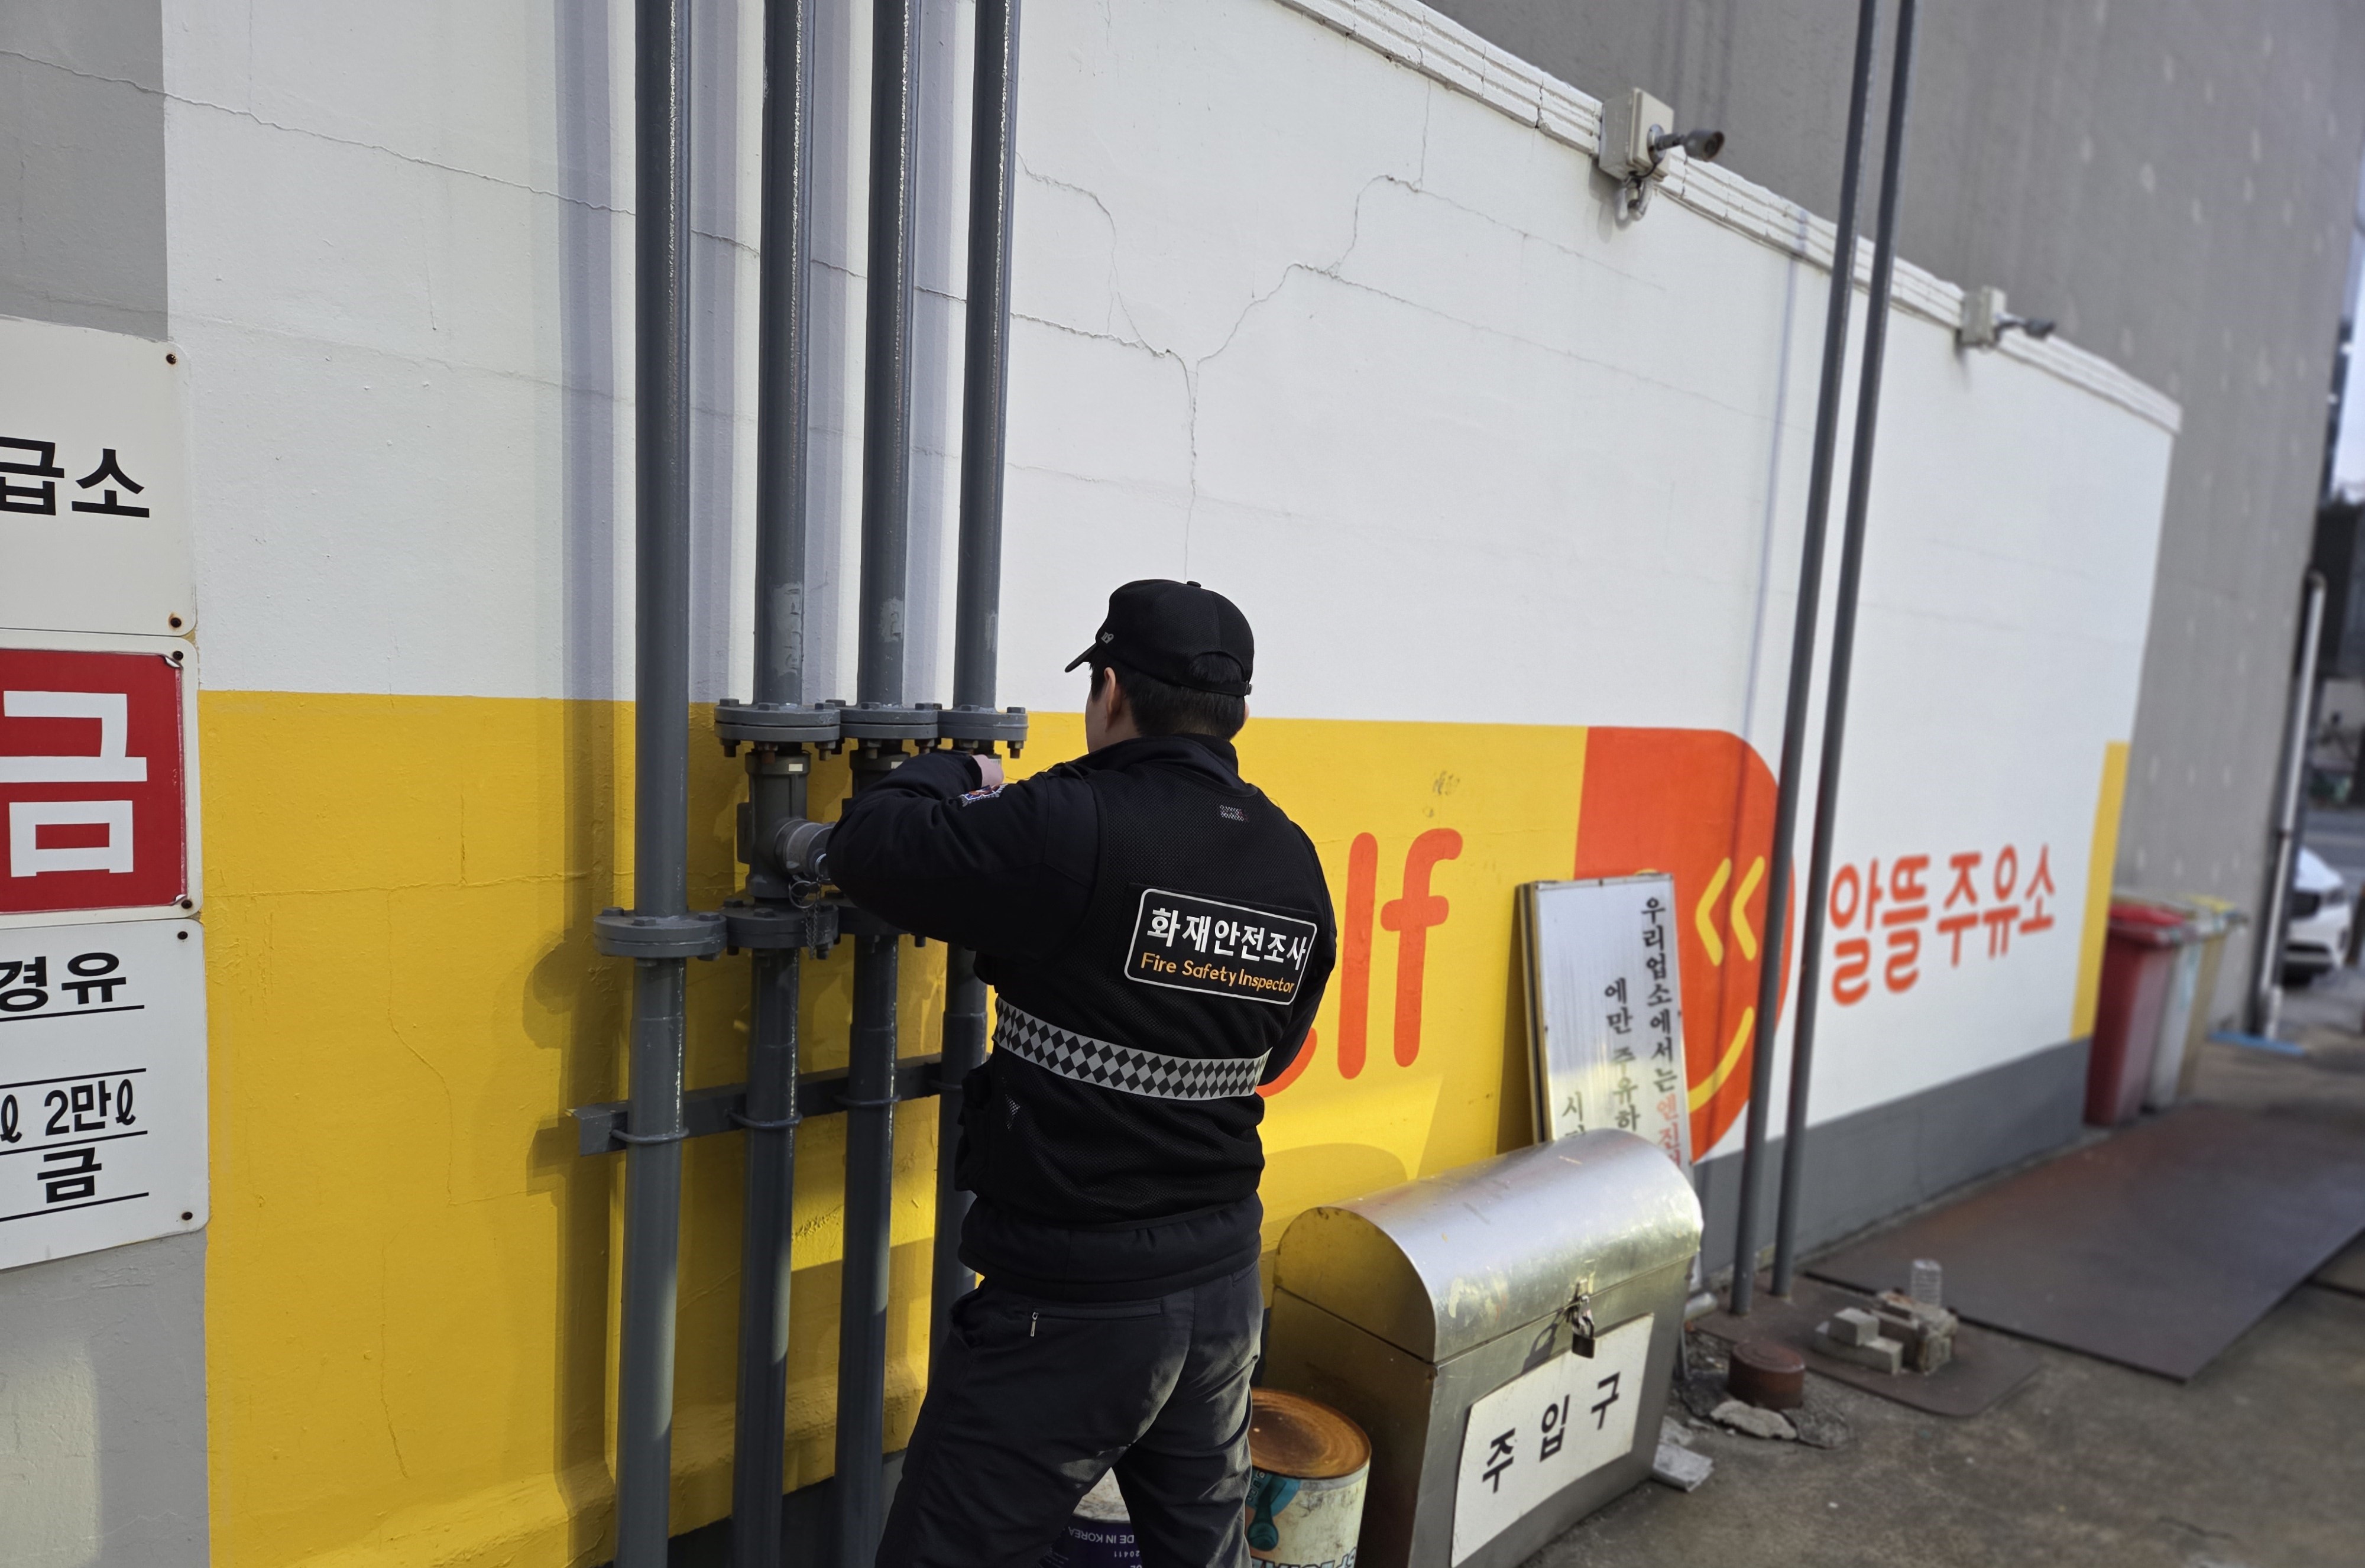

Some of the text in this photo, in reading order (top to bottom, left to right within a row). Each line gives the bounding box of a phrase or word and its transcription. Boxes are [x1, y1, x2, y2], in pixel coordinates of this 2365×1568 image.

[0, 690, 147, 877] 금
[1147, 907, 1307, 971] 화재안전조사
[1829, 843, 2056, 1007] 알뜰주유소
[0, 952, 127, 1012] 경유
[1141, 952, 1295, 993] Fire Safety Inspector
[37, 1146, 102, 1204] 금
[1068, 1526, 1135, 1544] DE IN KOREA
